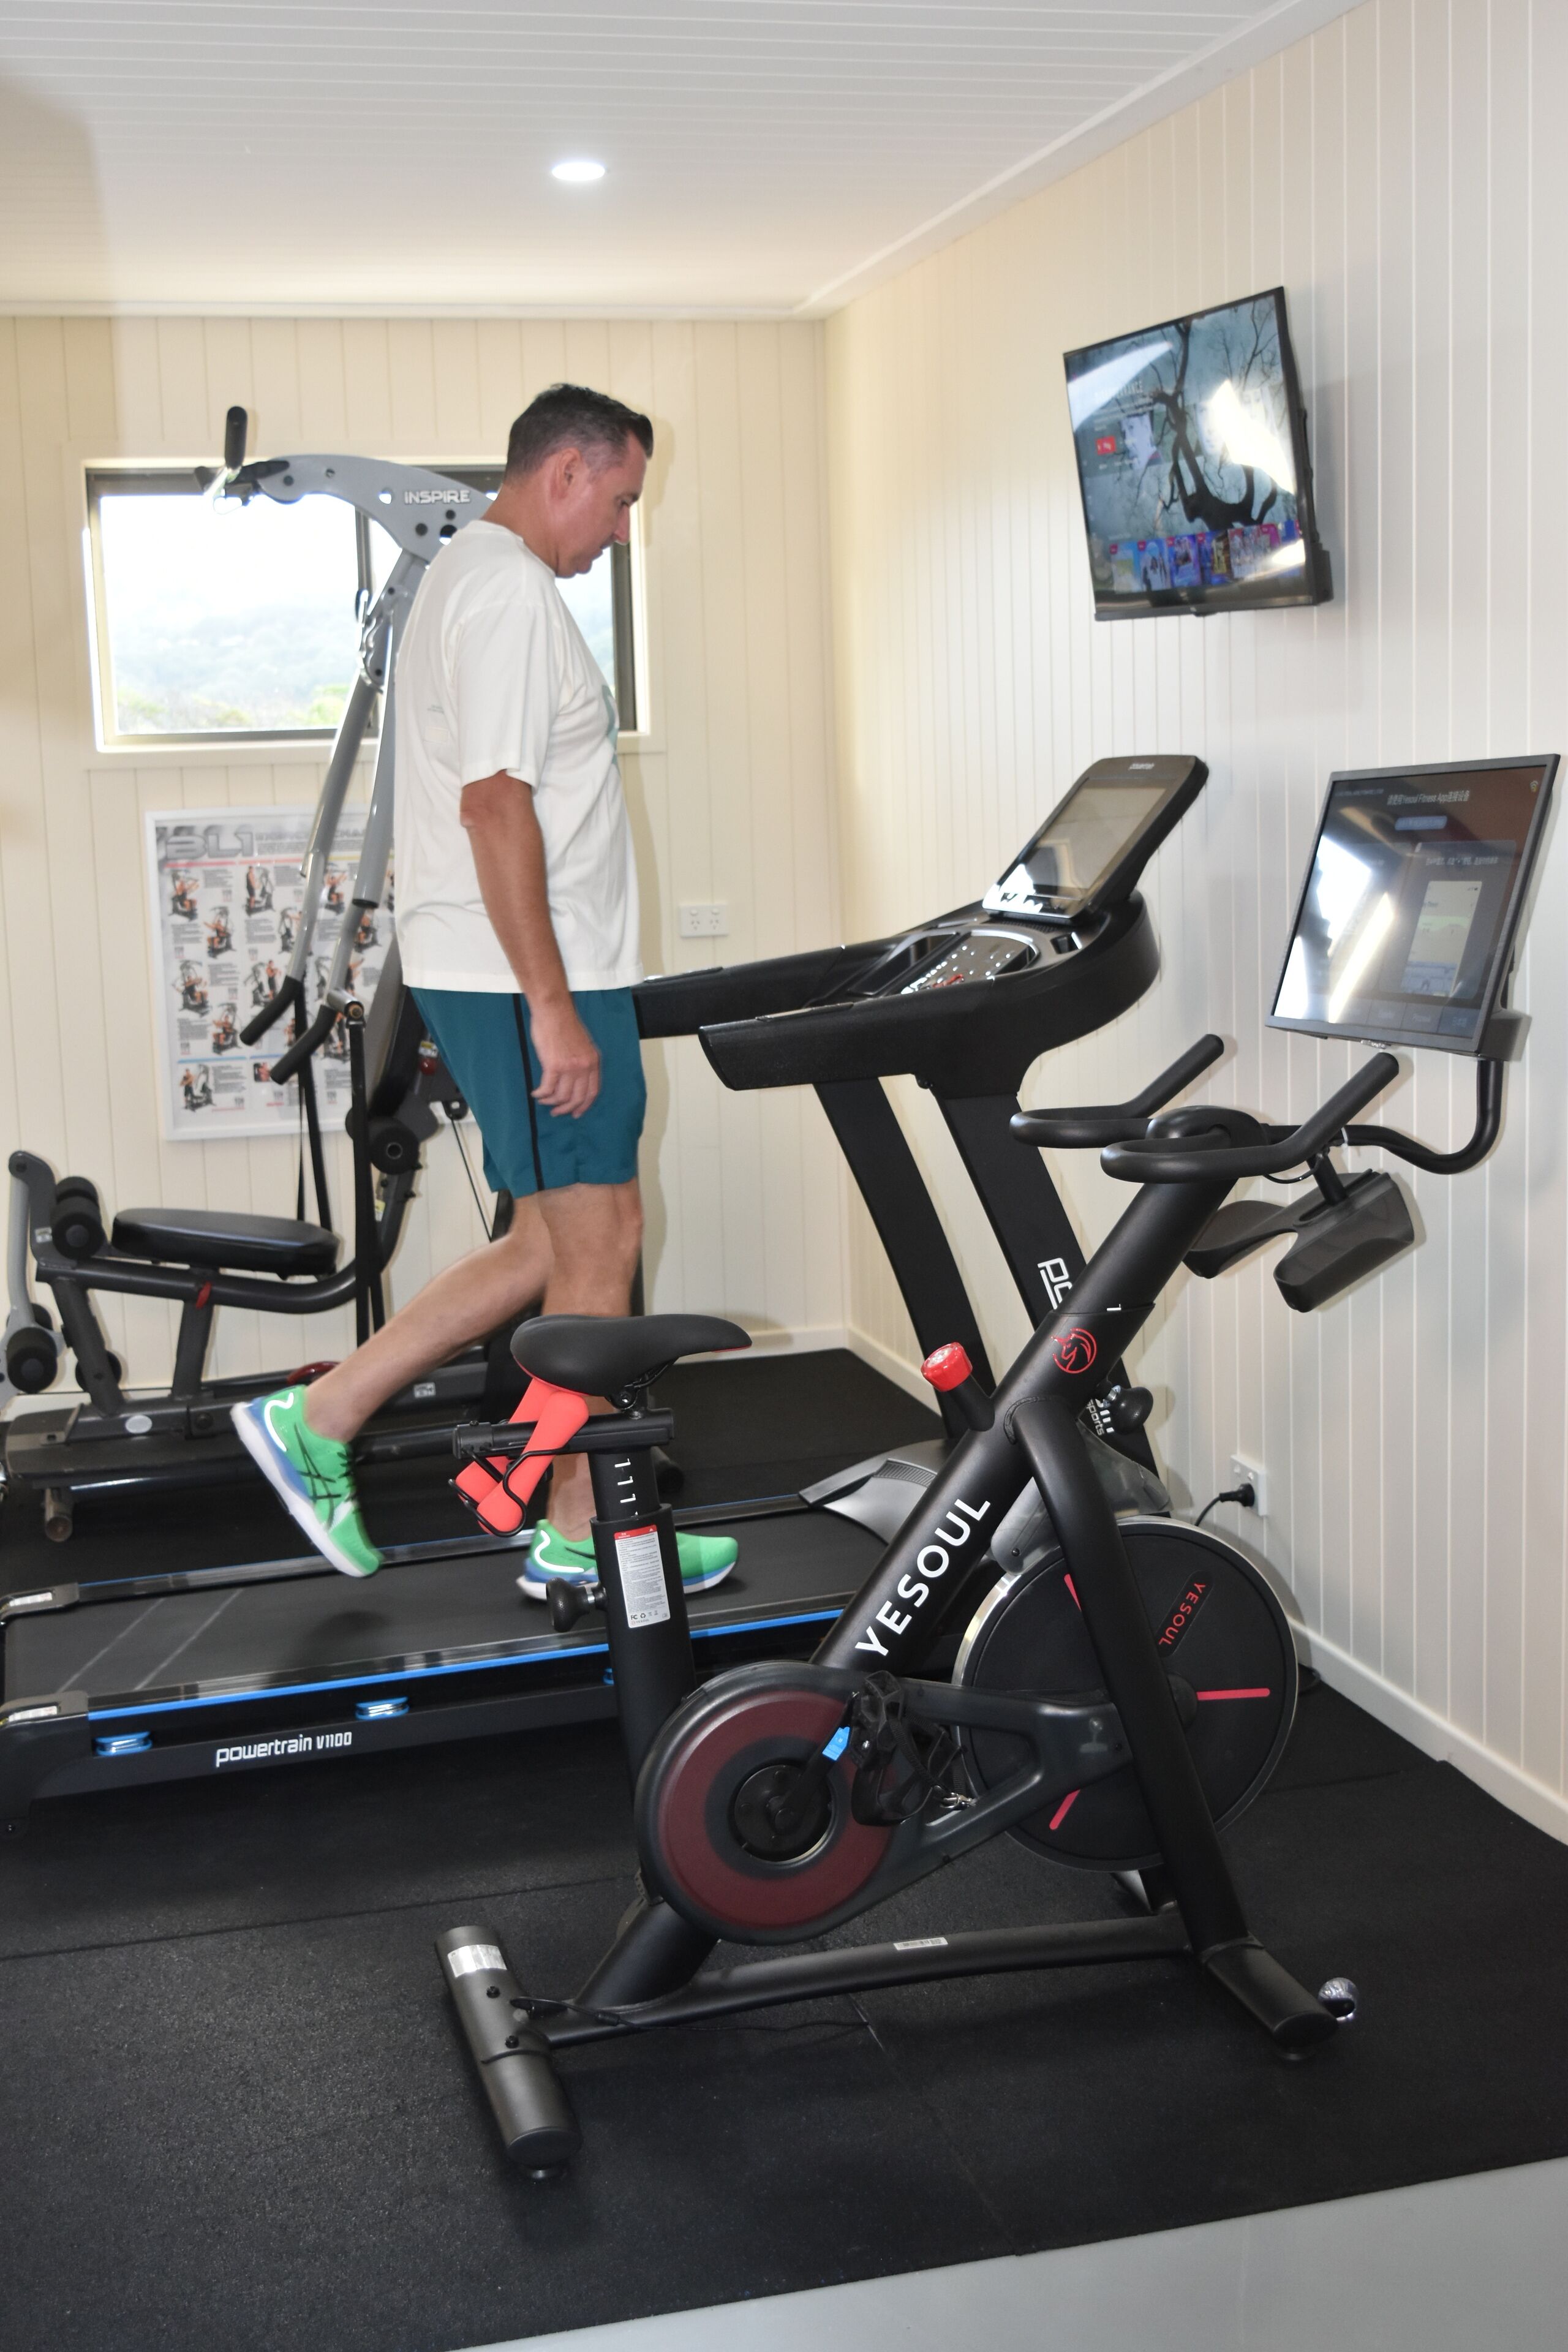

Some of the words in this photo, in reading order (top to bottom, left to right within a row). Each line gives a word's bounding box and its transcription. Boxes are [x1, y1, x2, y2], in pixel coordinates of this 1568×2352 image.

[404, 490, 470, 503] INSPIRE
[854, 1499, 990, 1656] YESOUL
[1158, 1583, 1206, 1645] YESOUL
[216, 1734, 312, 1768] powertrain
